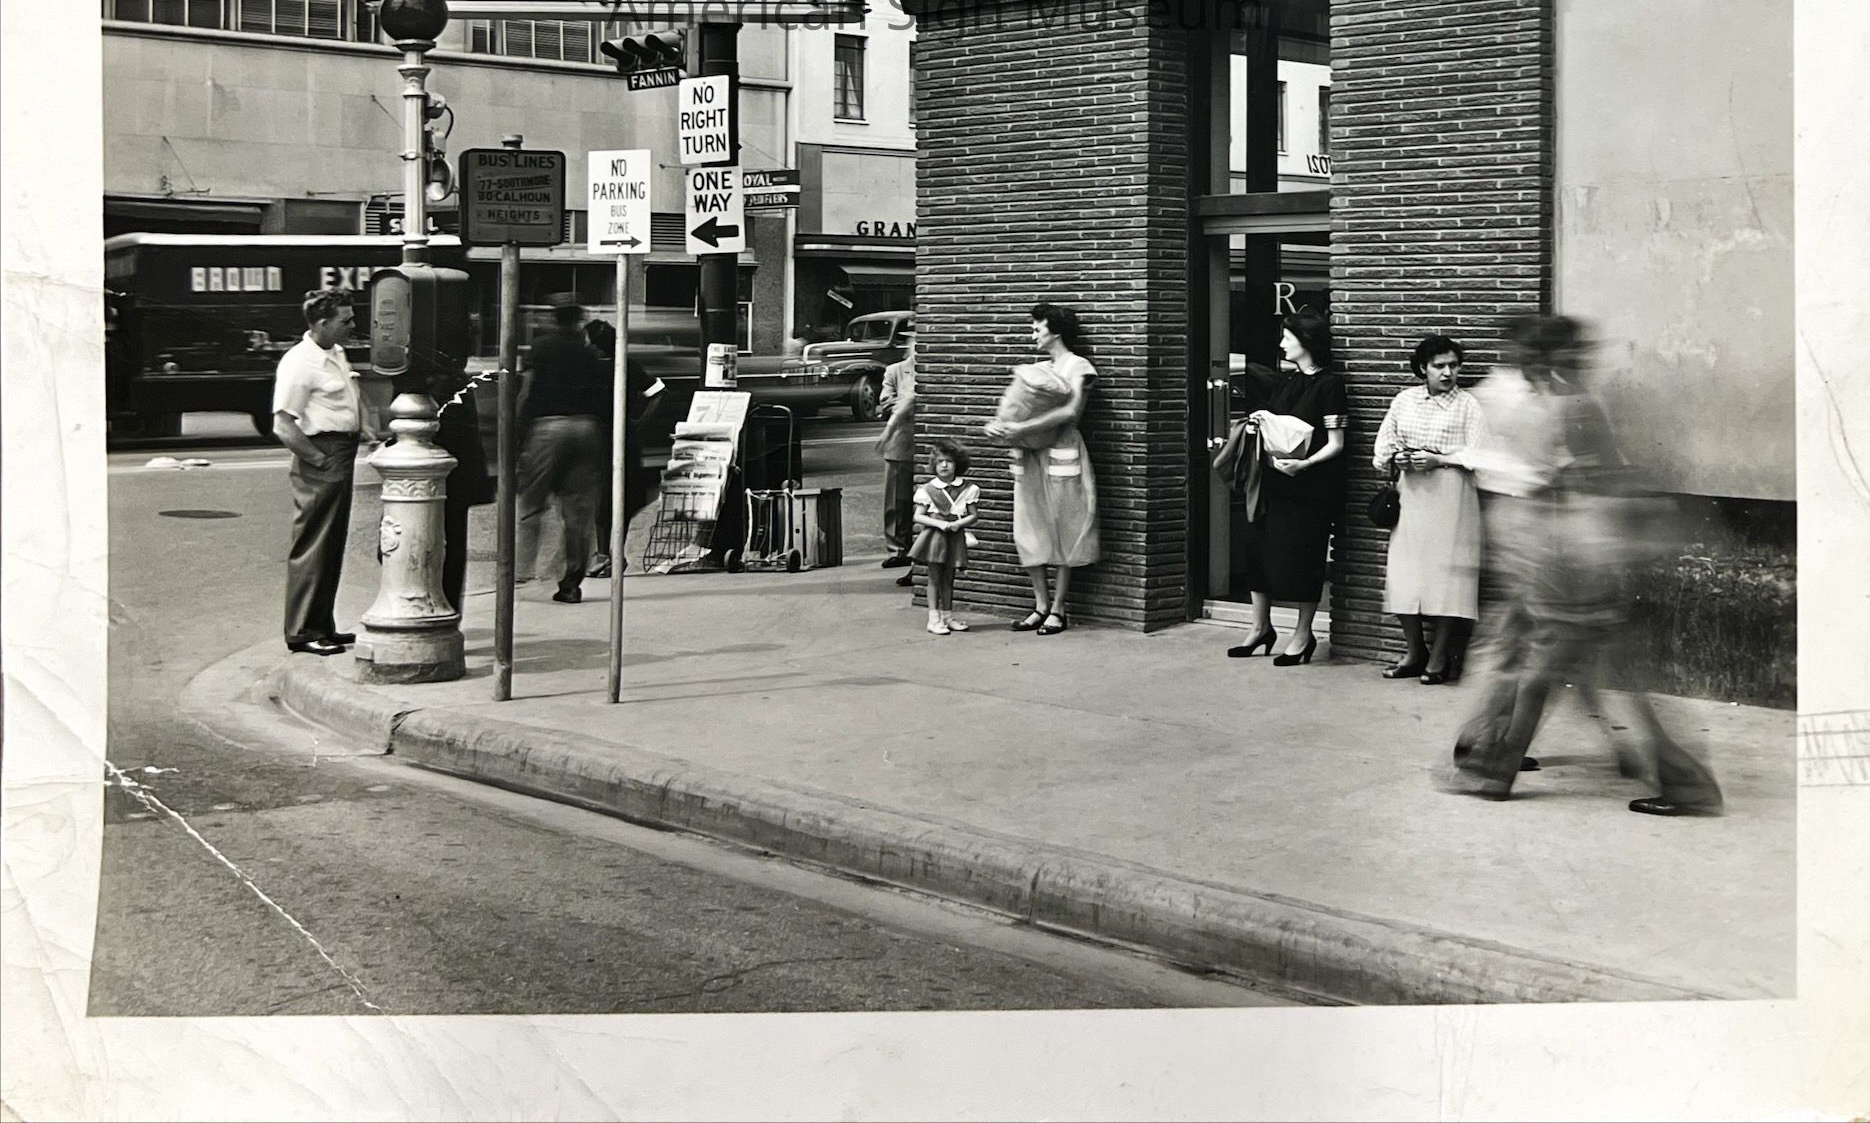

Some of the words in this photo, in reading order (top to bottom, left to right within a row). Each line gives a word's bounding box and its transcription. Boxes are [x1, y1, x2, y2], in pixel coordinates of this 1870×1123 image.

[630, 72, 677, 89] FANNIN
[692, 84, 715, 105] NO
[680, 108, 727, 130] RIGHT
[682, 132, 727, 155] TURN
[478, 153, 508, 168] BUS
[514, 156, 556, 169] LINES
[610, 158, 628, 178] NO
[592, 180, 646, 201] PARKING
[692, 170, 734, 192] ONE
[610, 204, 628, 218] BUS
[693, 192, 734, 214] WAY
[487, 209, 541, 221] HEIGHTS
[607, 221, 630, 235] ZONE
